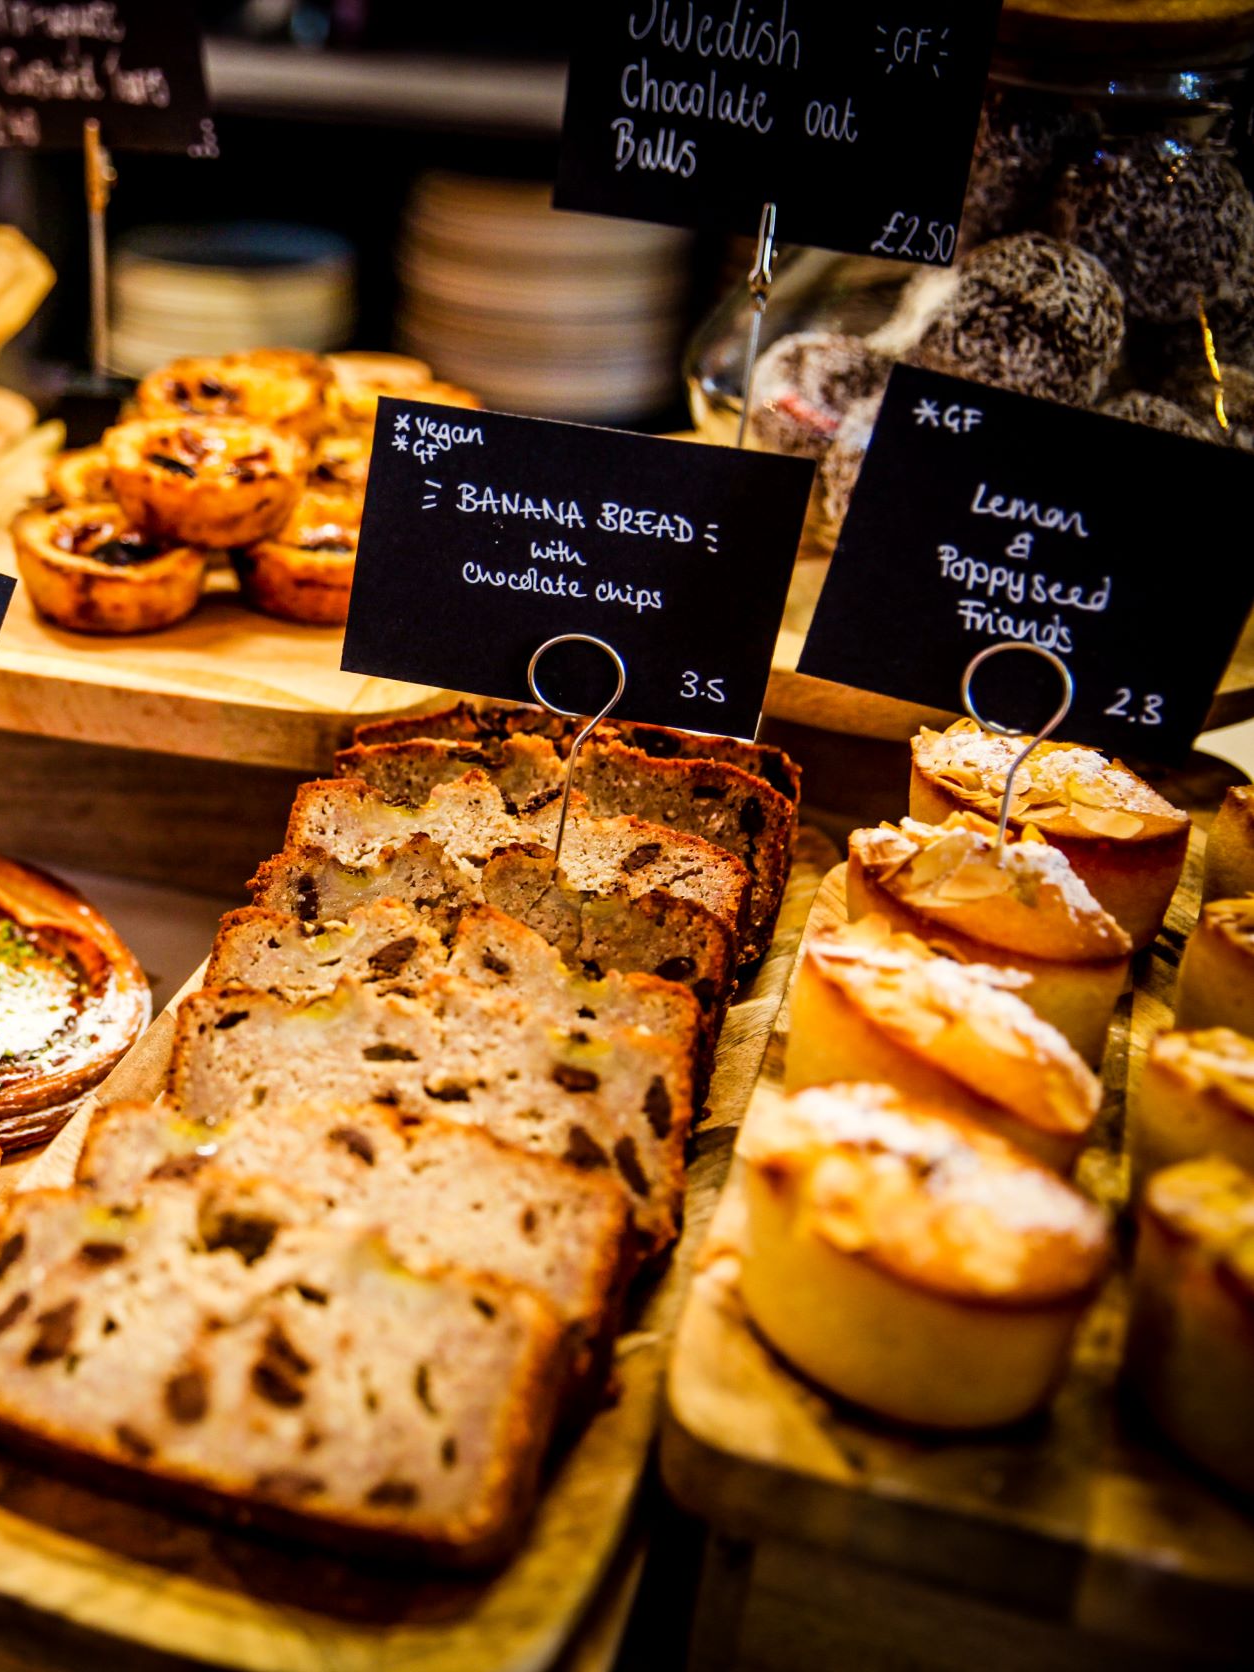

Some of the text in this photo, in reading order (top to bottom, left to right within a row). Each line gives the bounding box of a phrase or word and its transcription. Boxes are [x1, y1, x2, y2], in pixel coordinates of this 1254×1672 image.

[894, 28, 931, 63] GF
[621, 58, 857, 142] Chocolate oat
[612, 117, 697, 177] Balls
[871, 212, 955, 262] £2.50
[456, 483, 693, 542] BANANA BREAD
[972, 484, 1088, 537] Lemon
[531, 541, 586, 566] with
[596, 582, 661, 613] chips
[680, 671, 725, 702] 3.5
[1105, 688, 1162, 724] 2.3
